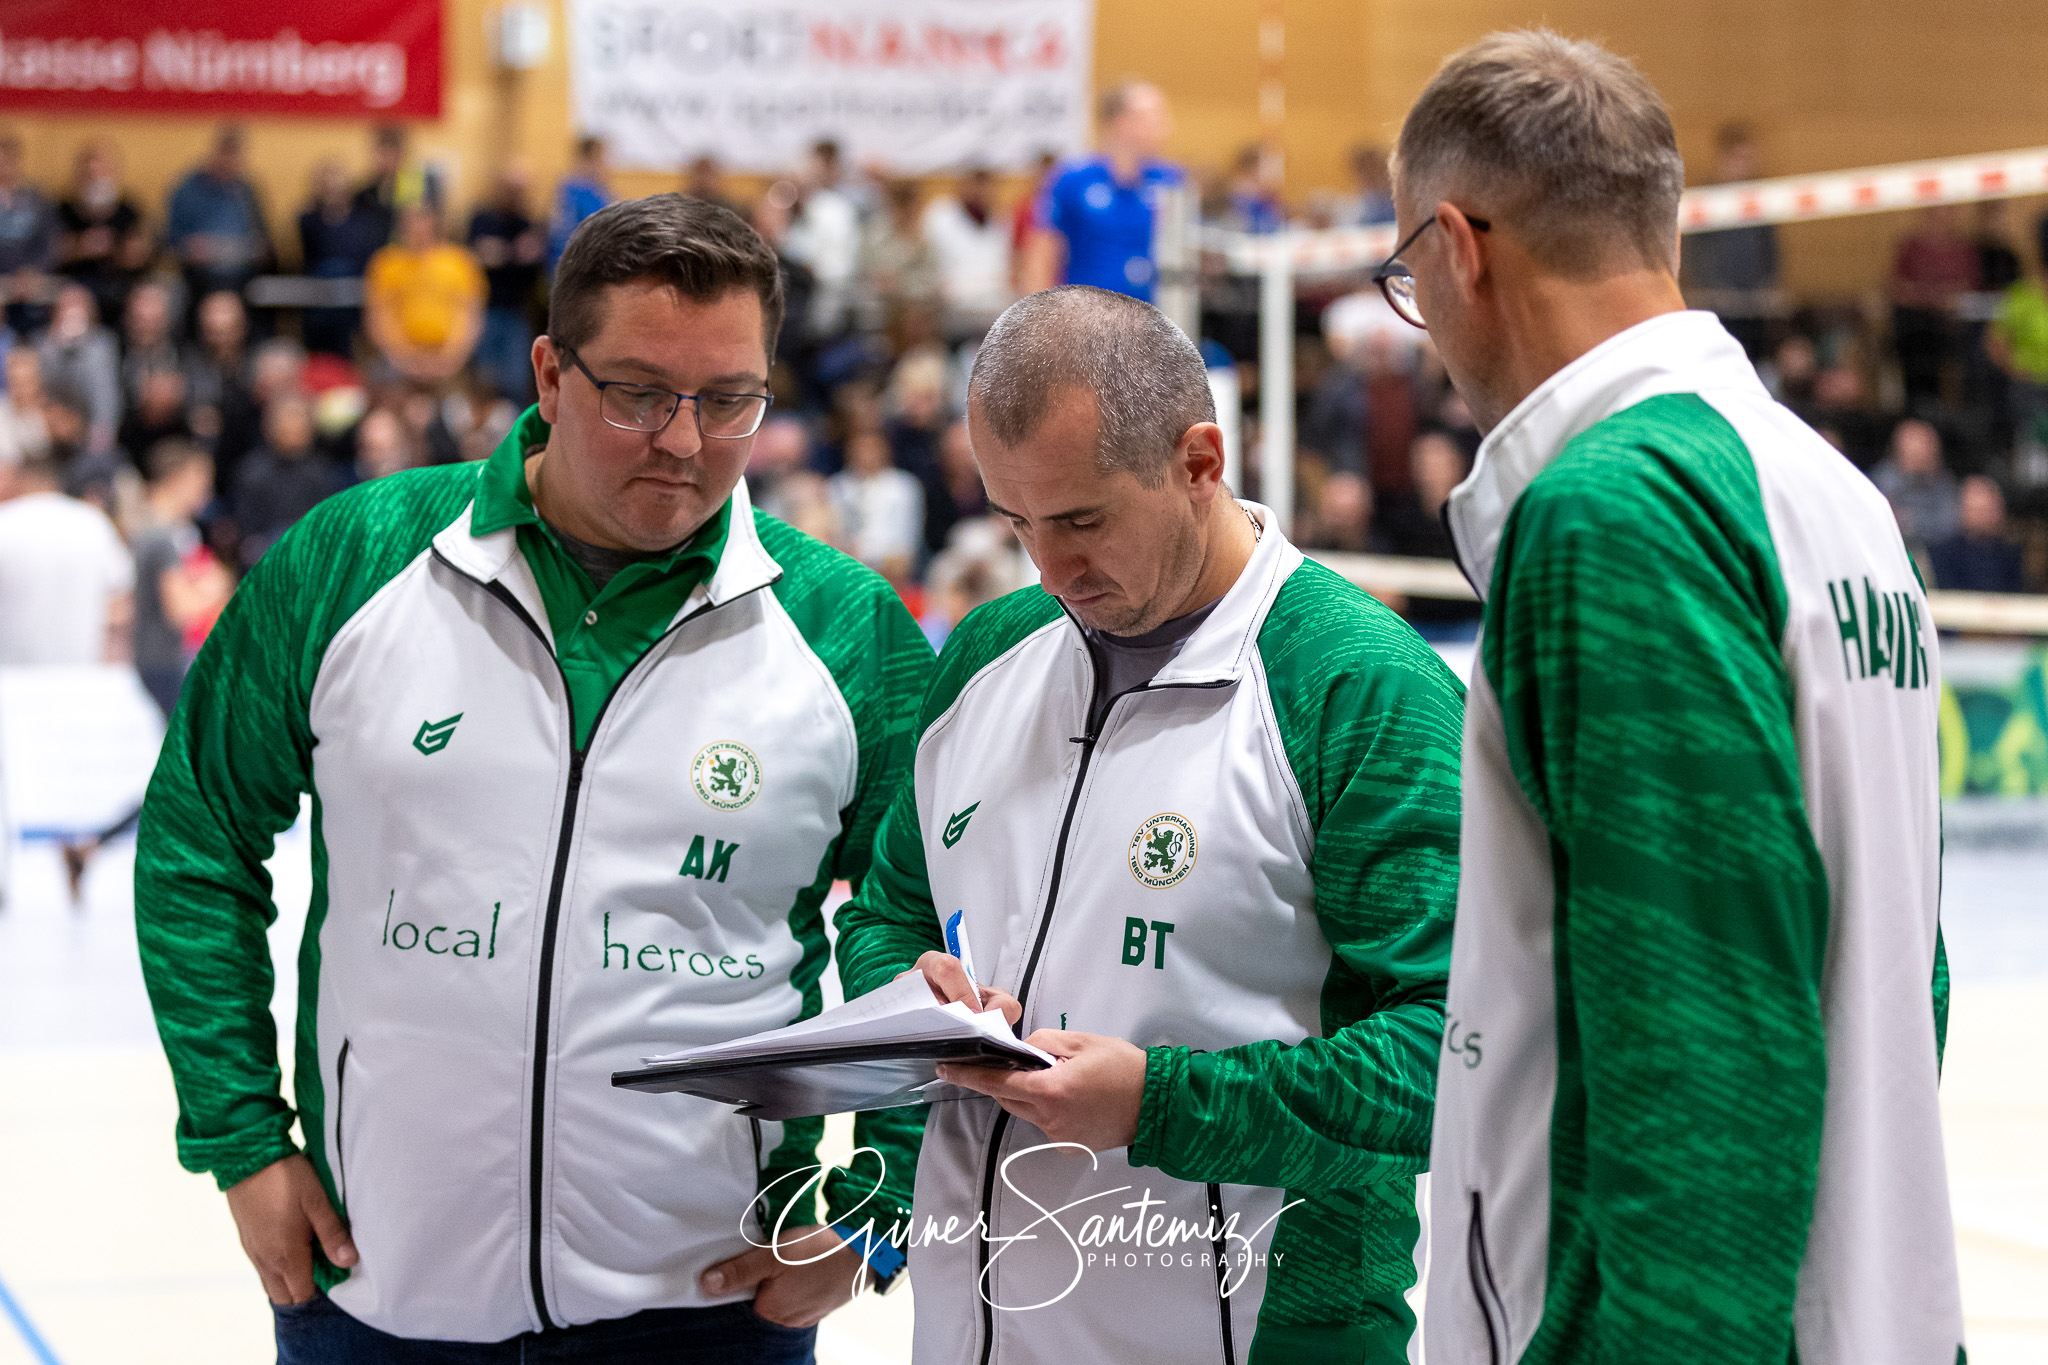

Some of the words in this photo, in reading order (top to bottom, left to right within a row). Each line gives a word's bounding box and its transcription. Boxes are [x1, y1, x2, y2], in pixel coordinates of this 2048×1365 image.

[148, 31, 402, 104] Nürnberg
[705, 743, 760, 785] UNTERHACHING
[711, 790, 756, 809] MÜNCHEN
[679, 834, 740, 883] AK
[1131, 828, 1144, 848] TSV
[1145, 815, 1195, 858] UNTERHACHING
[1143, 864, 1190, 887] MÜNCHEN
[382, 888, 500, 959] local
[602, 911, 765, 979] heroes
[1121, 916, 1175, 970] BT
